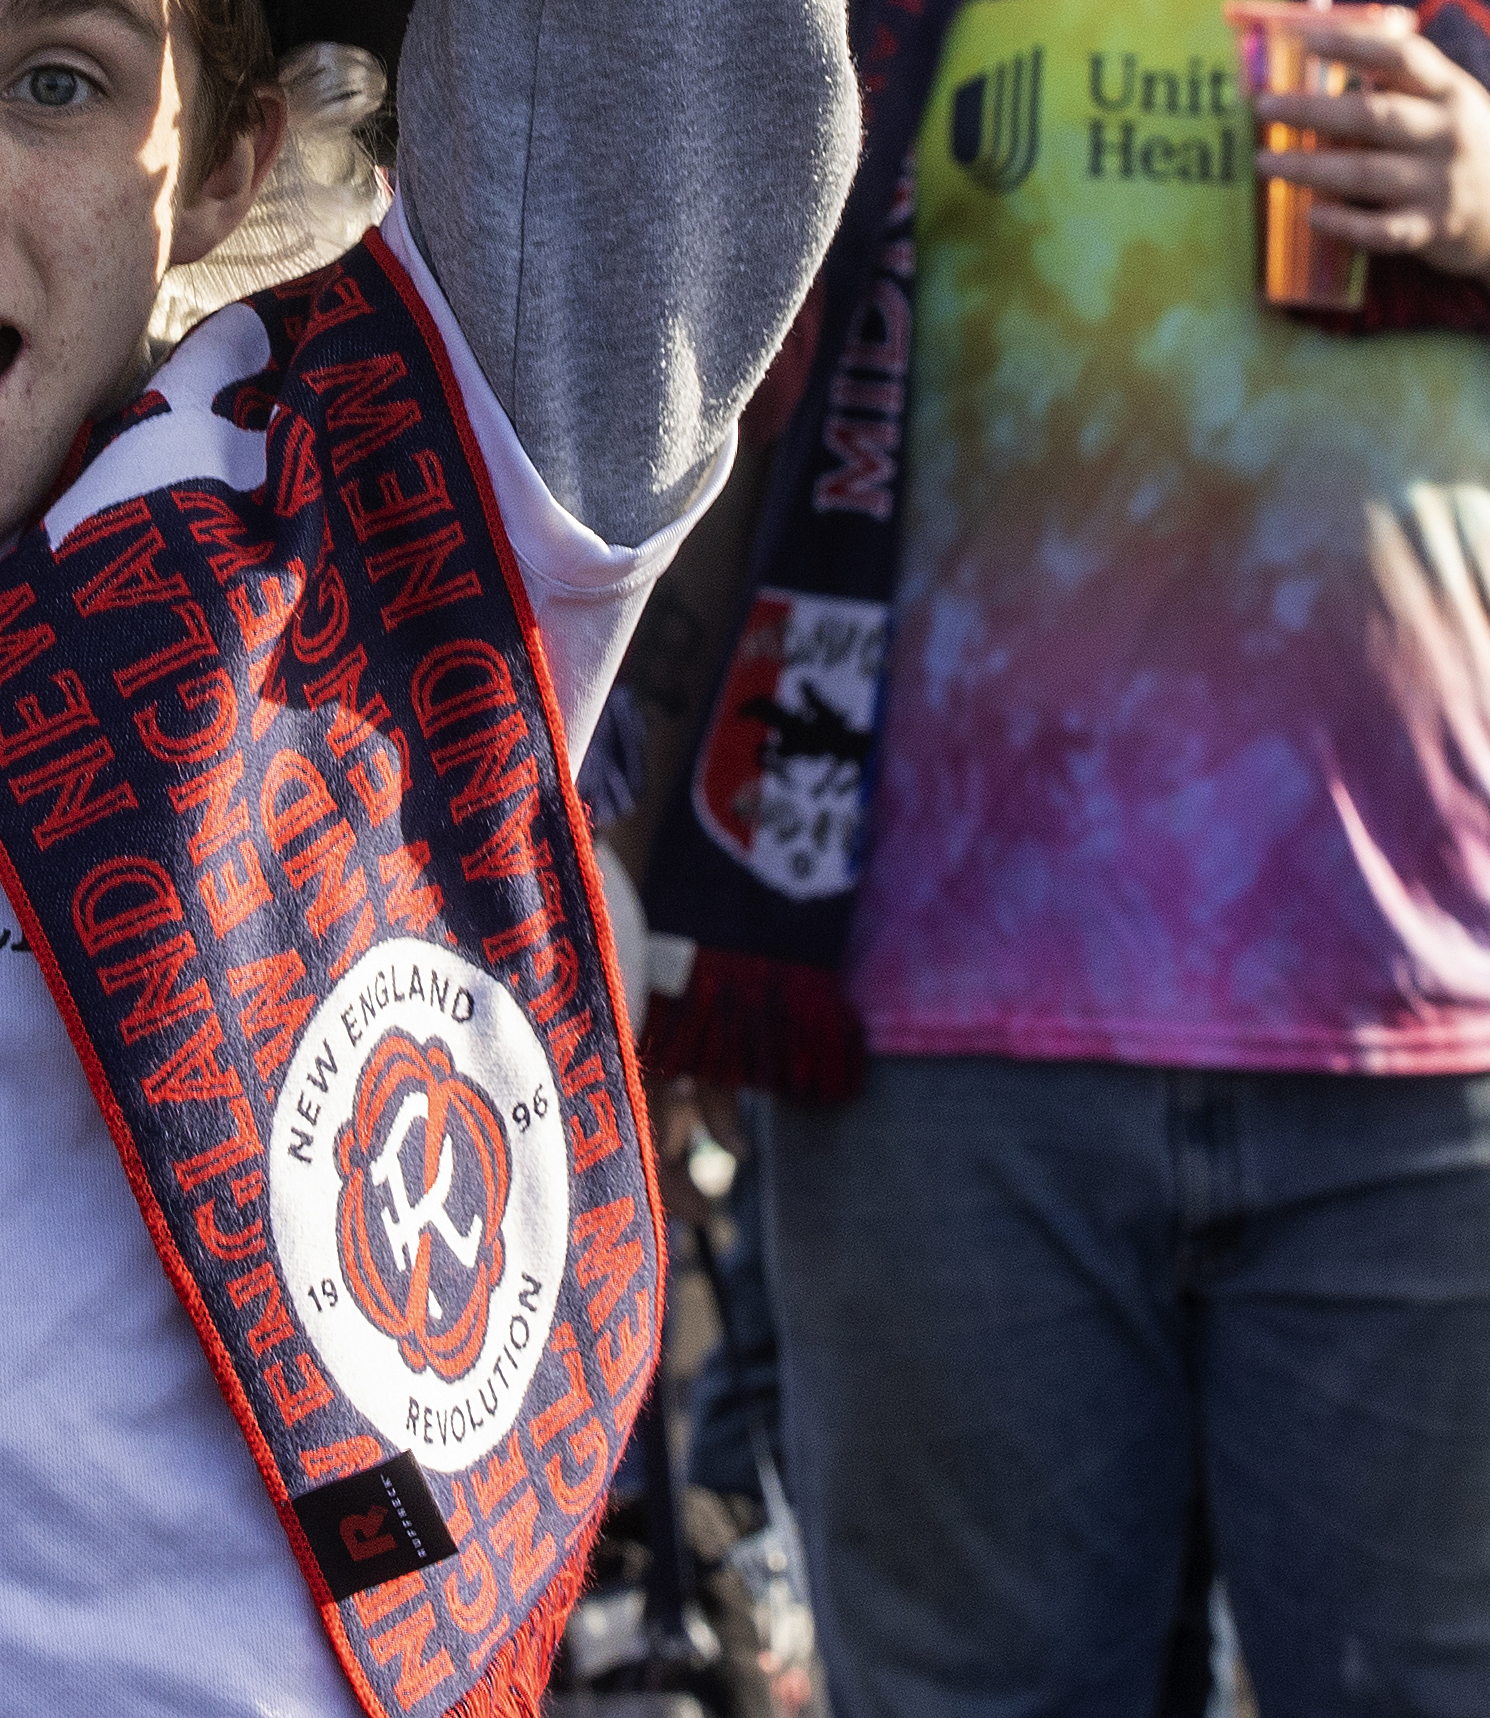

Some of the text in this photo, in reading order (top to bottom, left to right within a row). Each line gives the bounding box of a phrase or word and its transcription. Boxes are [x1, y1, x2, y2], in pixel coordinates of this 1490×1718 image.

[1087, 118, 1237, 187] Heal
[1088, 49, 1234, 118] Unit
[300, 349, 485, 630] NEW
[411, 638, 625, 1172] ENGLAND
[72, 854, 334, 1429] ENGLAND
[287, 1036, 339, 1164] NEW
[340, 963, 475, 1048] ENGLAND
[510, 1083, 550, 1135] 96
[307, 1277, 340, 1314] 19
[404, 1272, 544, 1446] REVOLUTION
[571, 1193, 654, 1433] EW
[338, 1503, 398, 1563] R
